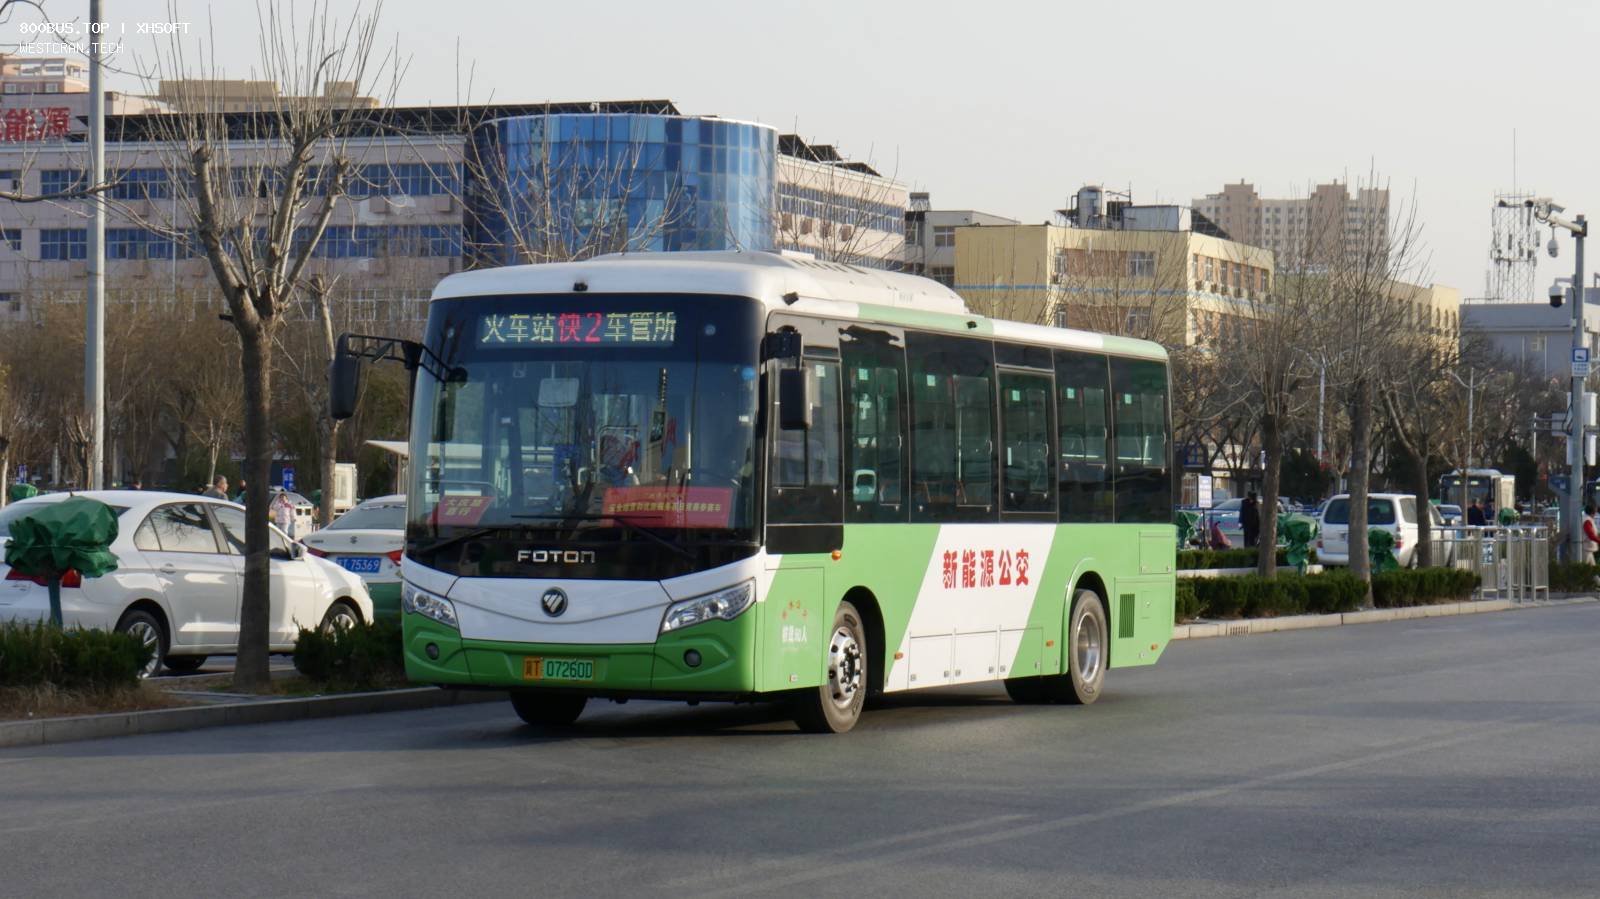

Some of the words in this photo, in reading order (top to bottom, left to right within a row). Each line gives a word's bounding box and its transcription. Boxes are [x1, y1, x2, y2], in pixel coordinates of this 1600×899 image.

[0, 107, 70, 143] 能源
[517, 550, 595, 563] FOTON
[943, 548, 1029, 589] 新能源公交
